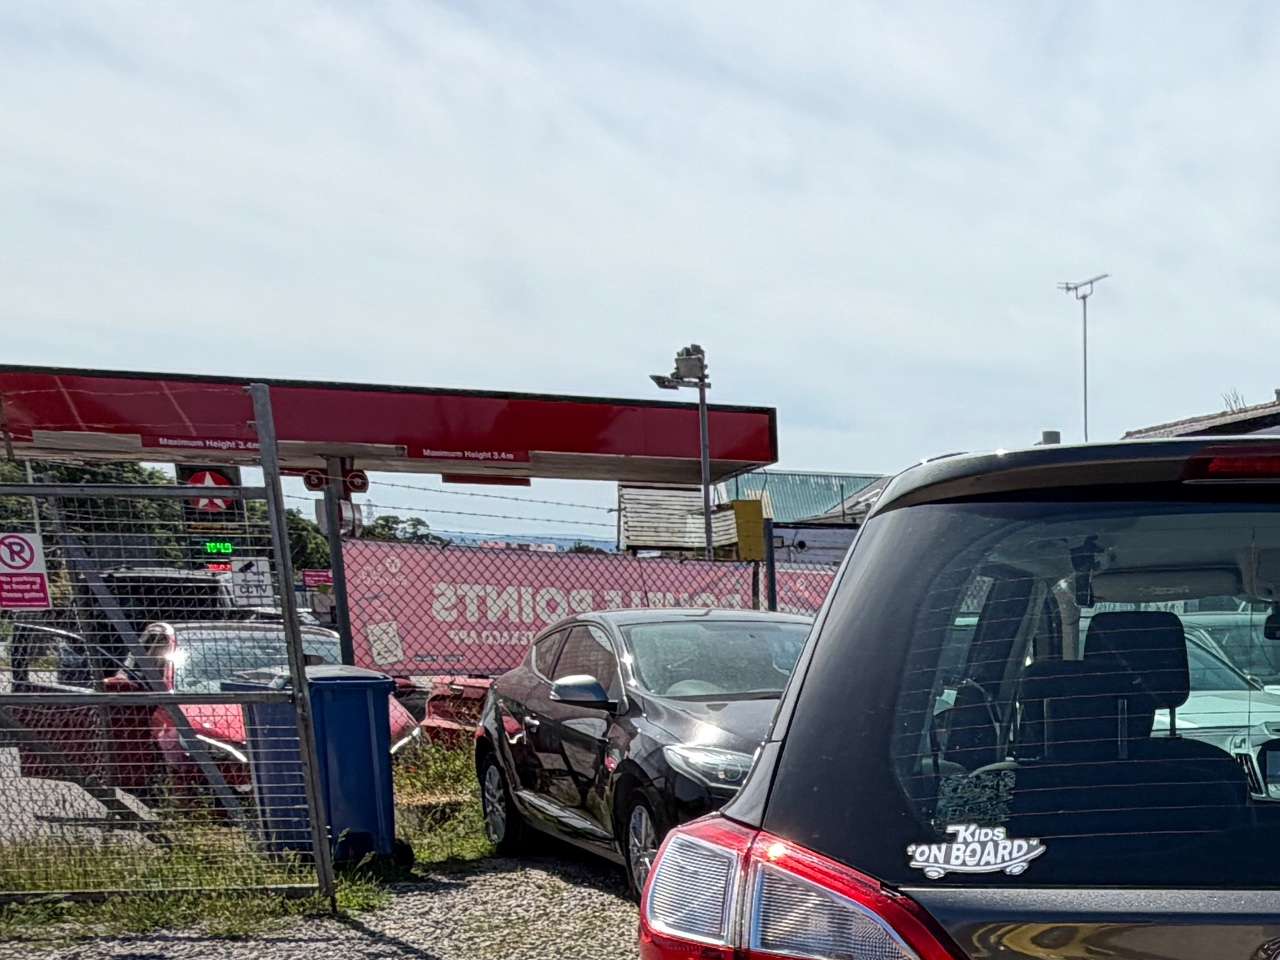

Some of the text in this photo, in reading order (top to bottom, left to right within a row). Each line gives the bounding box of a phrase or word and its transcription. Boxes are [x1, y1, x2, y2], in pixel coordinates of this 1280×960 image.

[159, 437, 204, 448] Maximum
[206, 440, 236, 450] Height
[423, 448, 514, 460] Maximum Height 3.4m
[240, 584, 267, 594] CCTV
